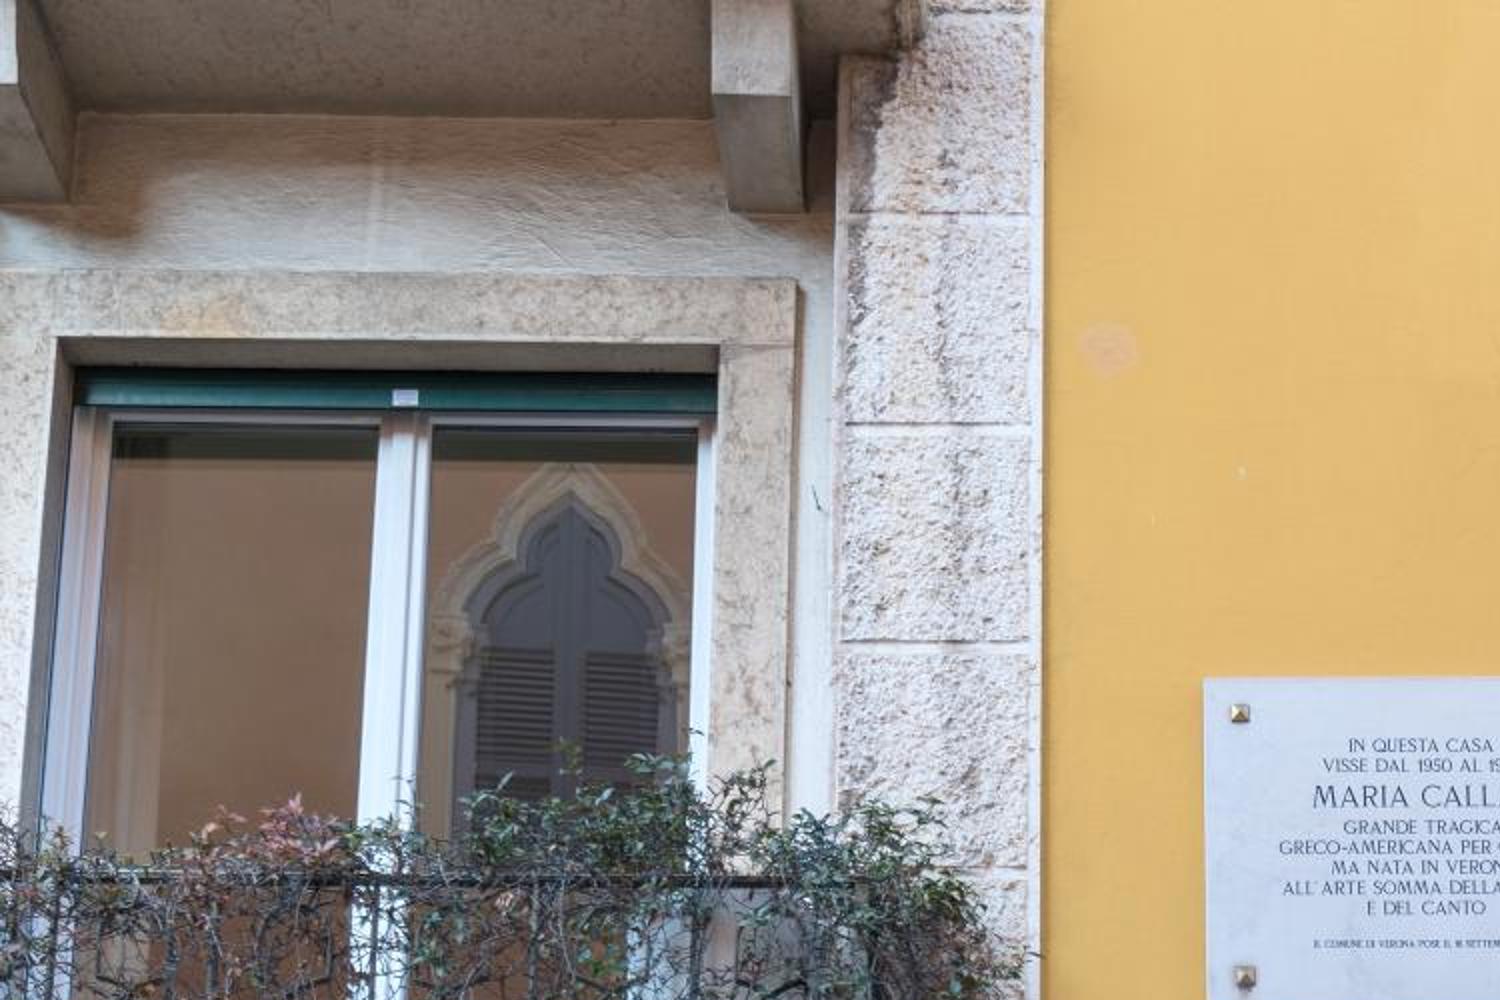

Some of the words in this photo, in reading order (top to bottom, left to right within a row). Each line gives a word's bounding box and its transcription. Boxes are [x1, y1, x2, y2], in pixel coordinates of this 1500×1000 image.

[1348, 737, 1366, 753] IN
[1372, 737, 1440, 754] QUESTA
[1446, 737, 1494, 753] CASA
[1322, 758, 1369, 773] VISSE
[1375, 758, 1410, 773] DAL
[1418, 758, 1453, 773] 1950
[1459, 758, 1482, 773] AL
[1312, 785, 1409, 809] MARIA
[1343, 819, 1417, 835] GRANDE
[1279, 839, 1453, 855] GRECO-AMERICANA
[1461, 839, 1492, 855] PER
[1331, 859, 1360, 875] MA
[1367, 859, 1414, 875] NATA
[1421, 859, 1439, 875] IN
[1373, 880, 1442, 895] SOMMA
[1367, 900, 1376, 916] E
[1383, 900, 1415, 916] DEL
[1421, 900, 1486, 916] CANTO
